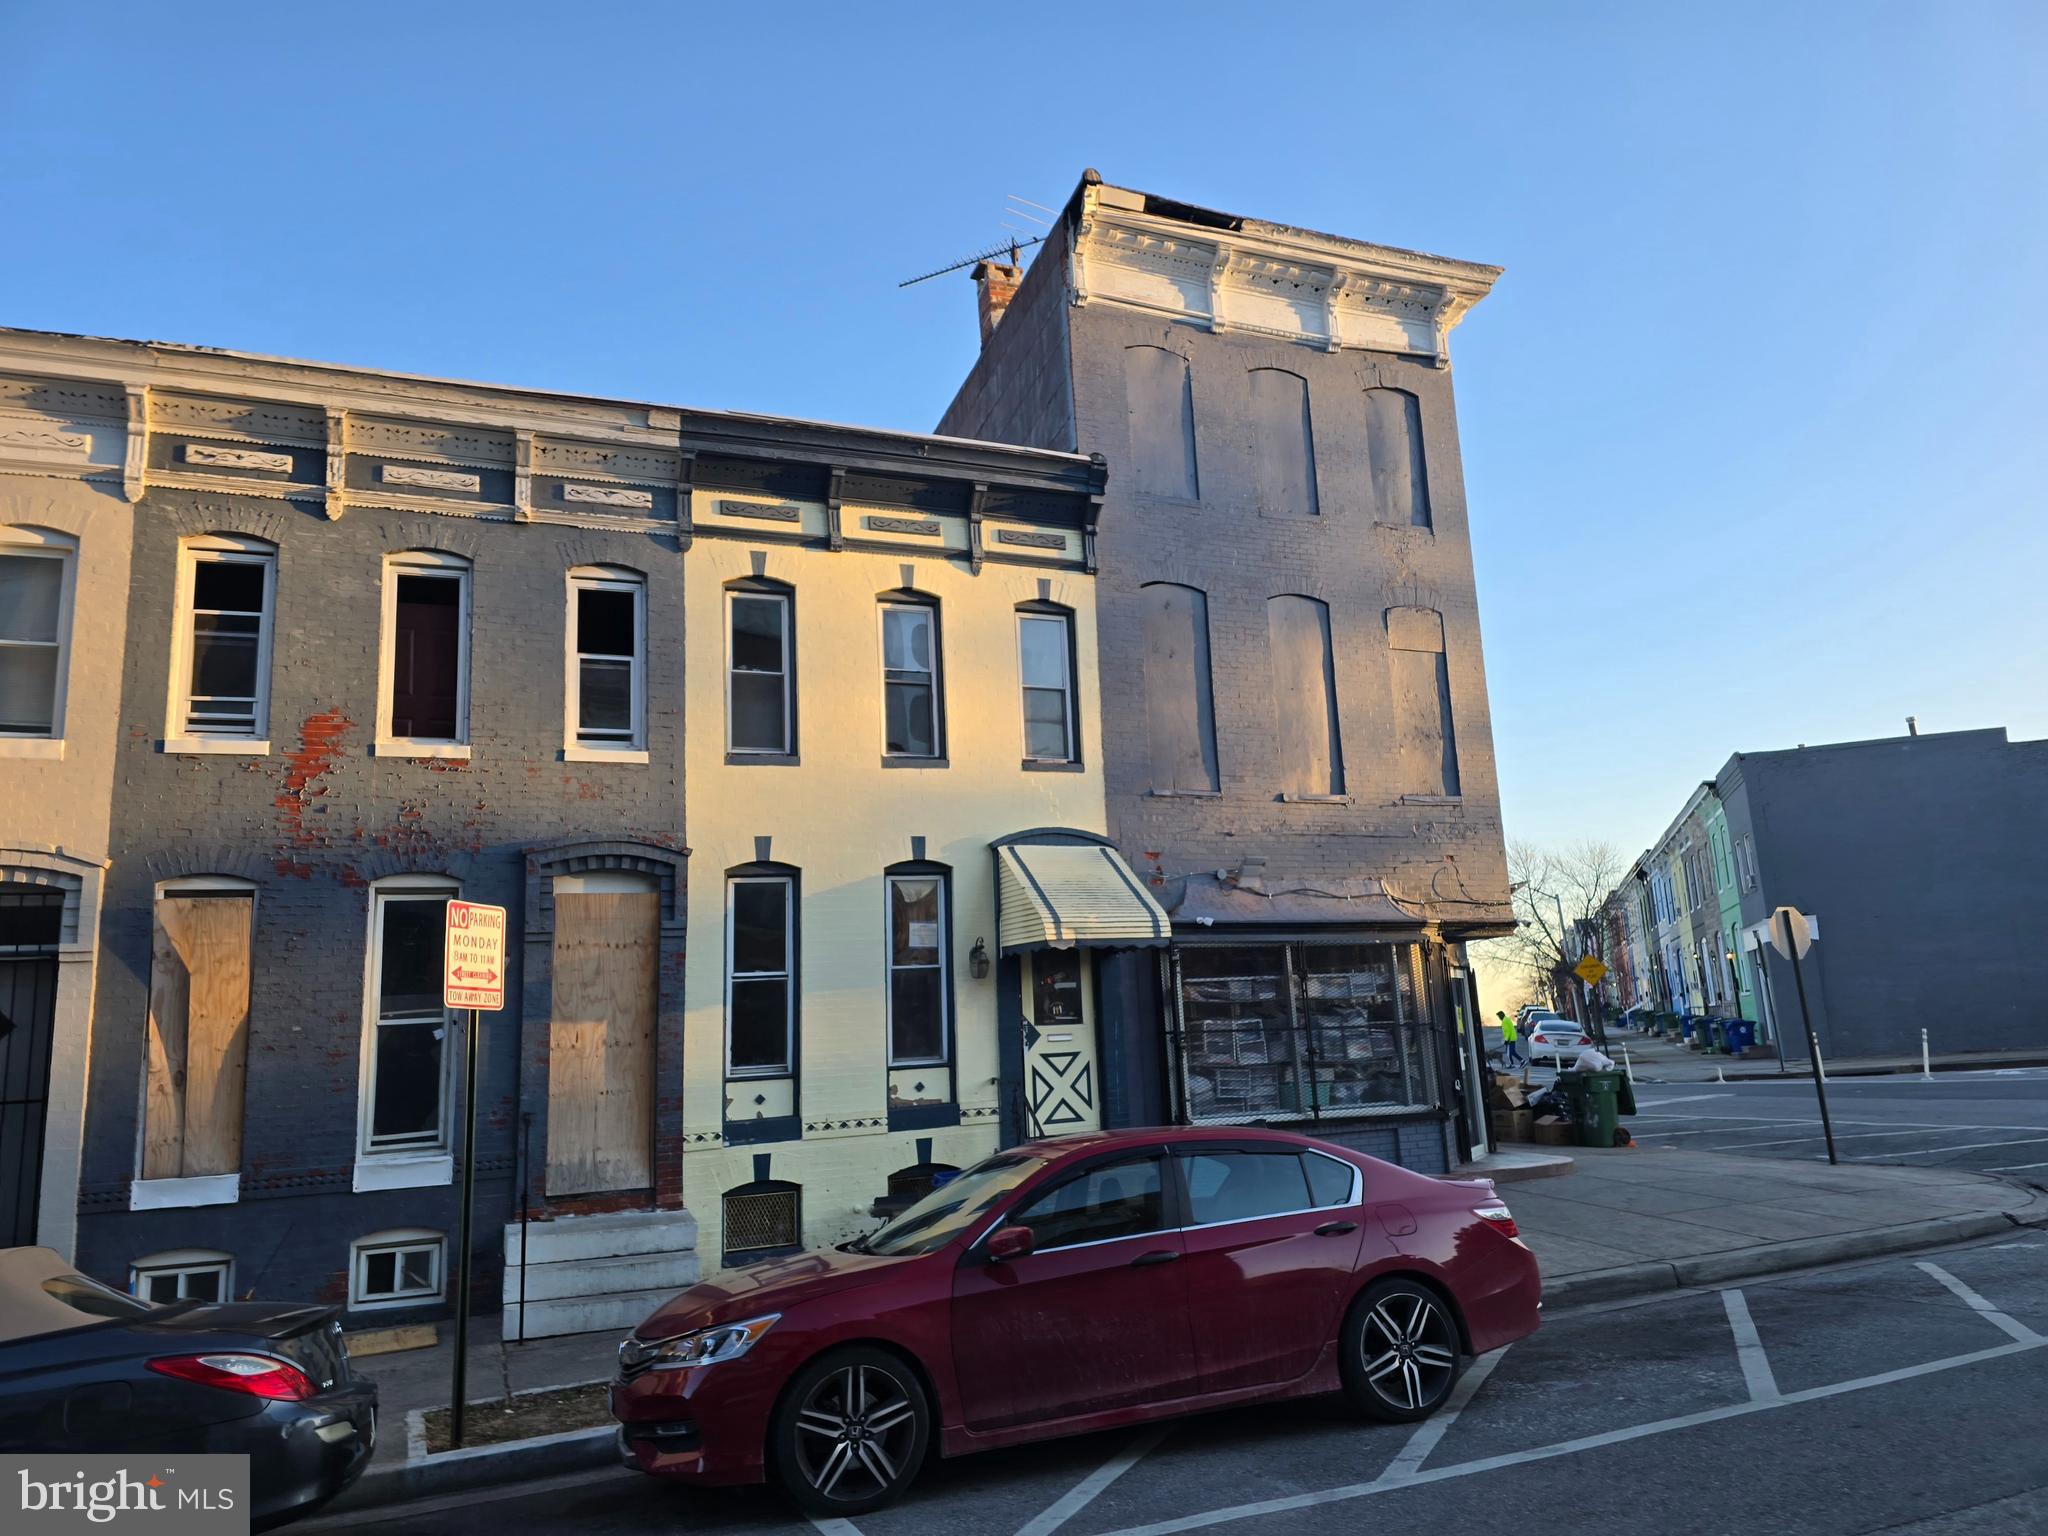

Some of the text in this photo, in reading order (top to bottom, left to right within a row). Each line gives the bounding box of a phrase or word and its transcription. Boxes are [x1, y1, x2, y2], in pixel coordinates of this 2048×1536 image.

[451, 907, 501, 929] NO PARKING
[453, 934, 498, 950] MONDAY
[470, 953, 478, 964] TO
[449, 991, 500, 1004] TOW AWAY ZONE
